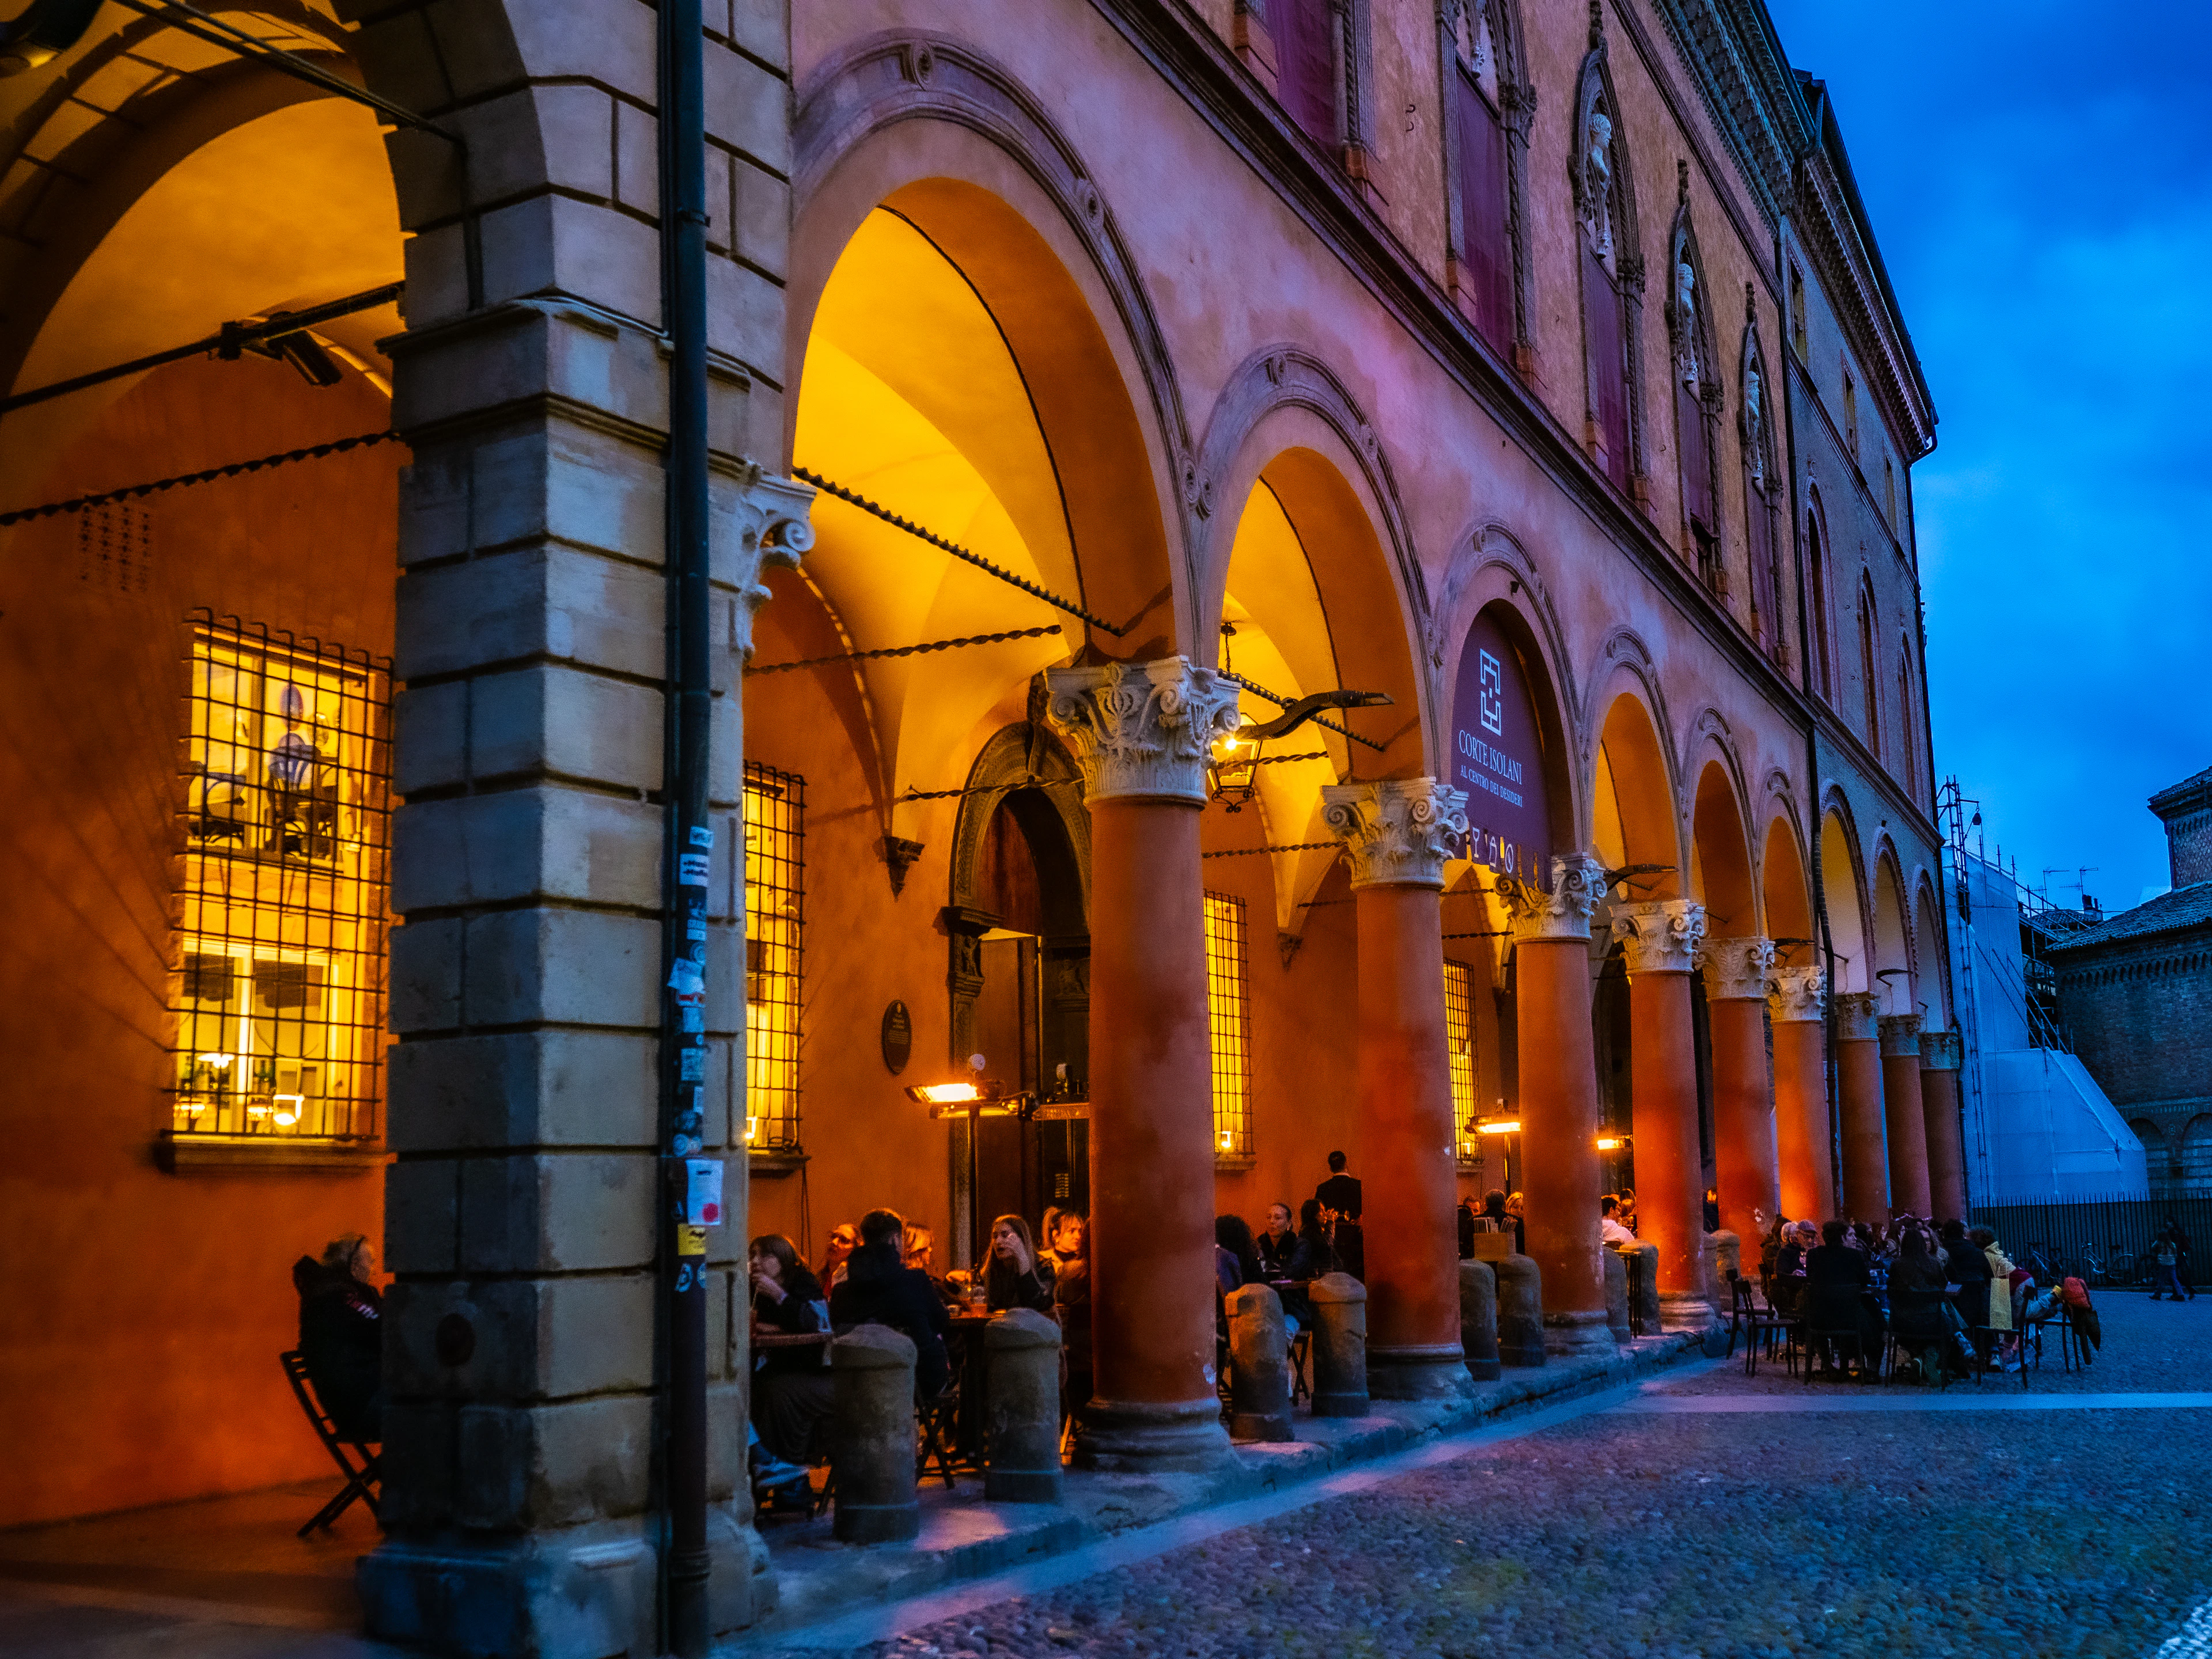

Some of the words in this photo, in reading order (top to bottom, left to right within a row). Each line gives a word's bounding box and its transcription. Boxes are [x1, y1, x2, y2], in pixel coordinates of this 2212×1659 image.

[1459, 730, 1488, 767] CORTE
[1490, 747, 1522, 785] ISOLANI
[1460, 764, 1468, 778] AL
[1468, 768, 1489, 790] CENTRO
[1490, 781, 1499, 796] DEI
[1500, 786, 1522, 808] DESIDERI
